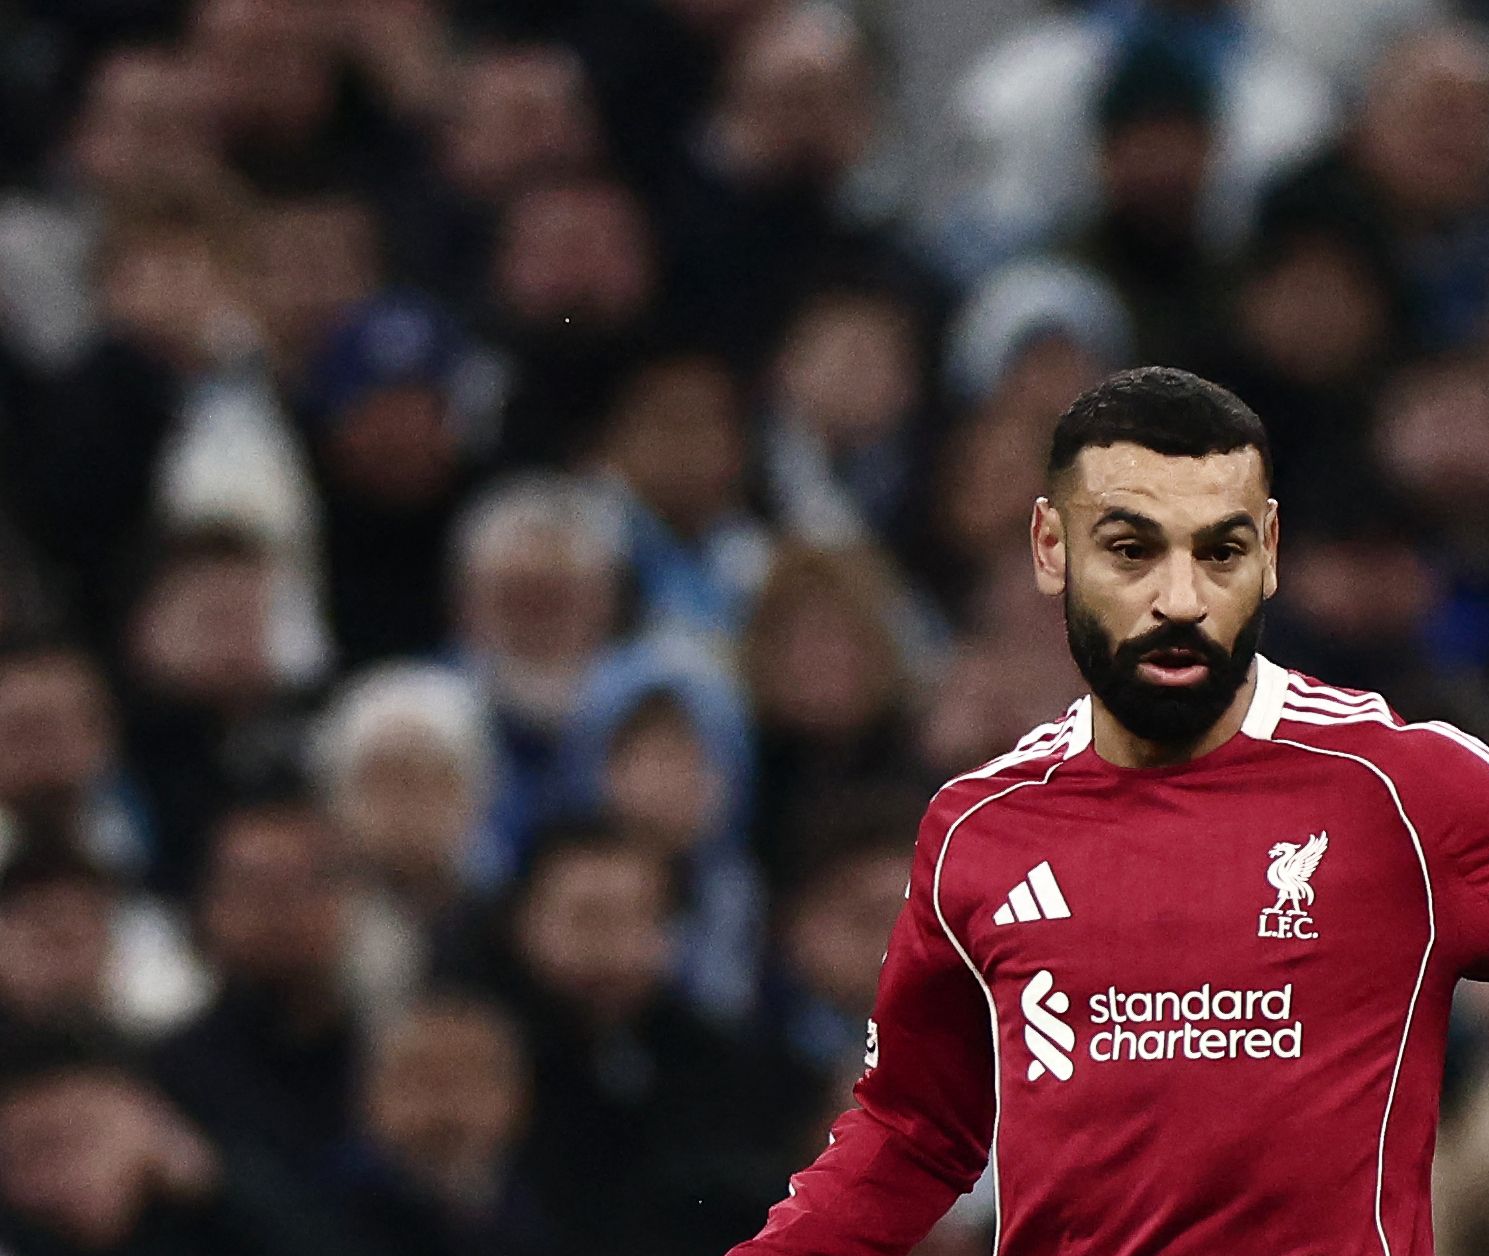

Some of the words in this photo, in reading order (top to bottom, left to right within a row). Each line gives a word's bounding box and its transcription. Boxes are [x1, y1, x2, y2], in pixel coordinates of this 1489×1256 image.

[1257, 914, 1319, 940] L.F.C.
[1089, 983, 1292, 1024] standard
[1089, 1020, 1303, 1062] chartered
